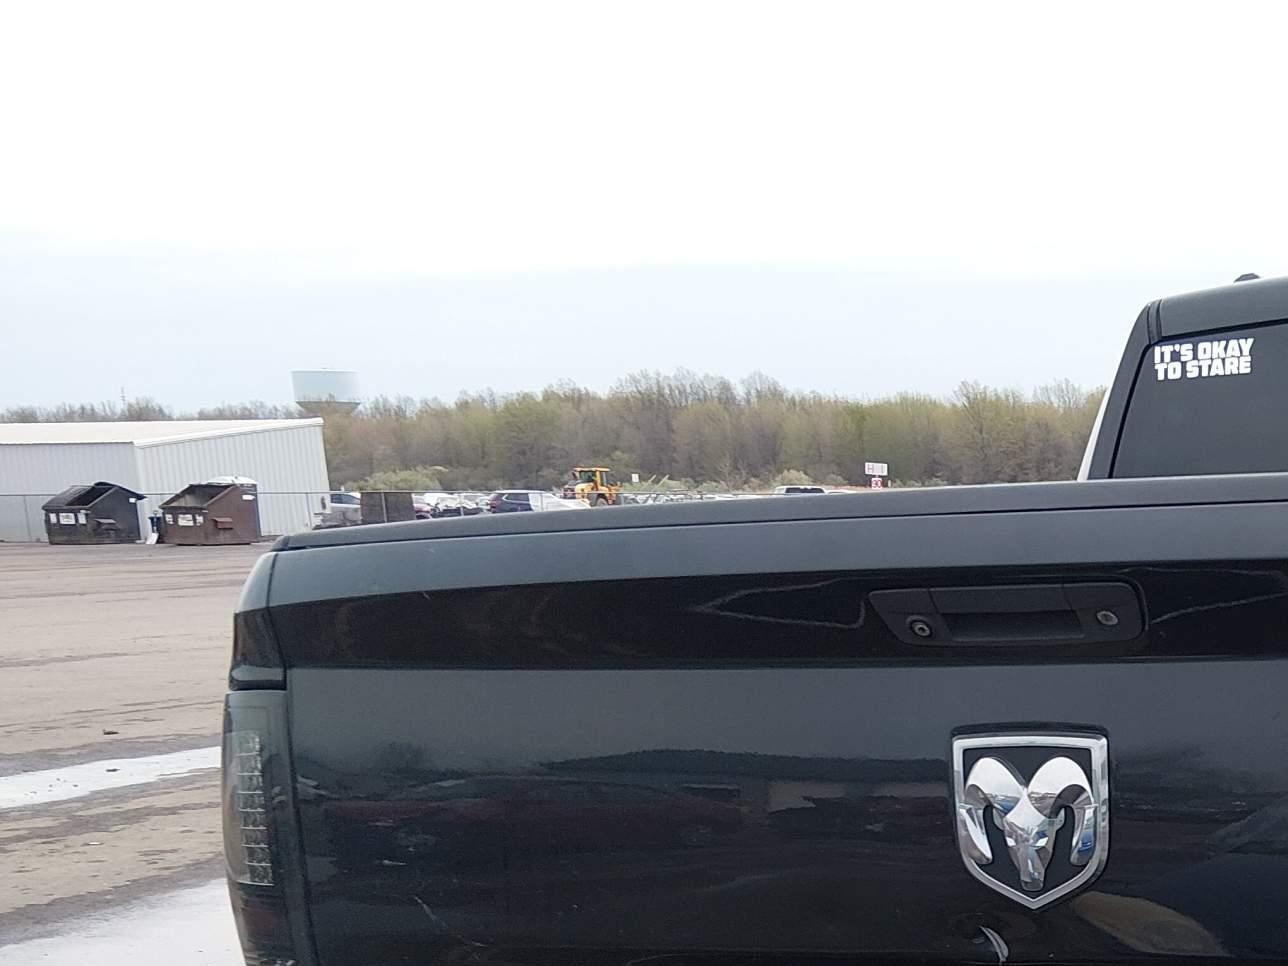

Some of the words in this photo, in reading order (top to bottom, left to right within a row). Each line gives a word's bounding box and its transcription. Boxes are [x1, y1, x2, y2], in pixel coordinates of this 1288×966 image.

[1154, 343, 1194, 364] IT'S
[1197, 337, 1255, 360] OKAY
[1154, 361, 1182, 381] TO
[1186, 355, 1252, 379] STARE
